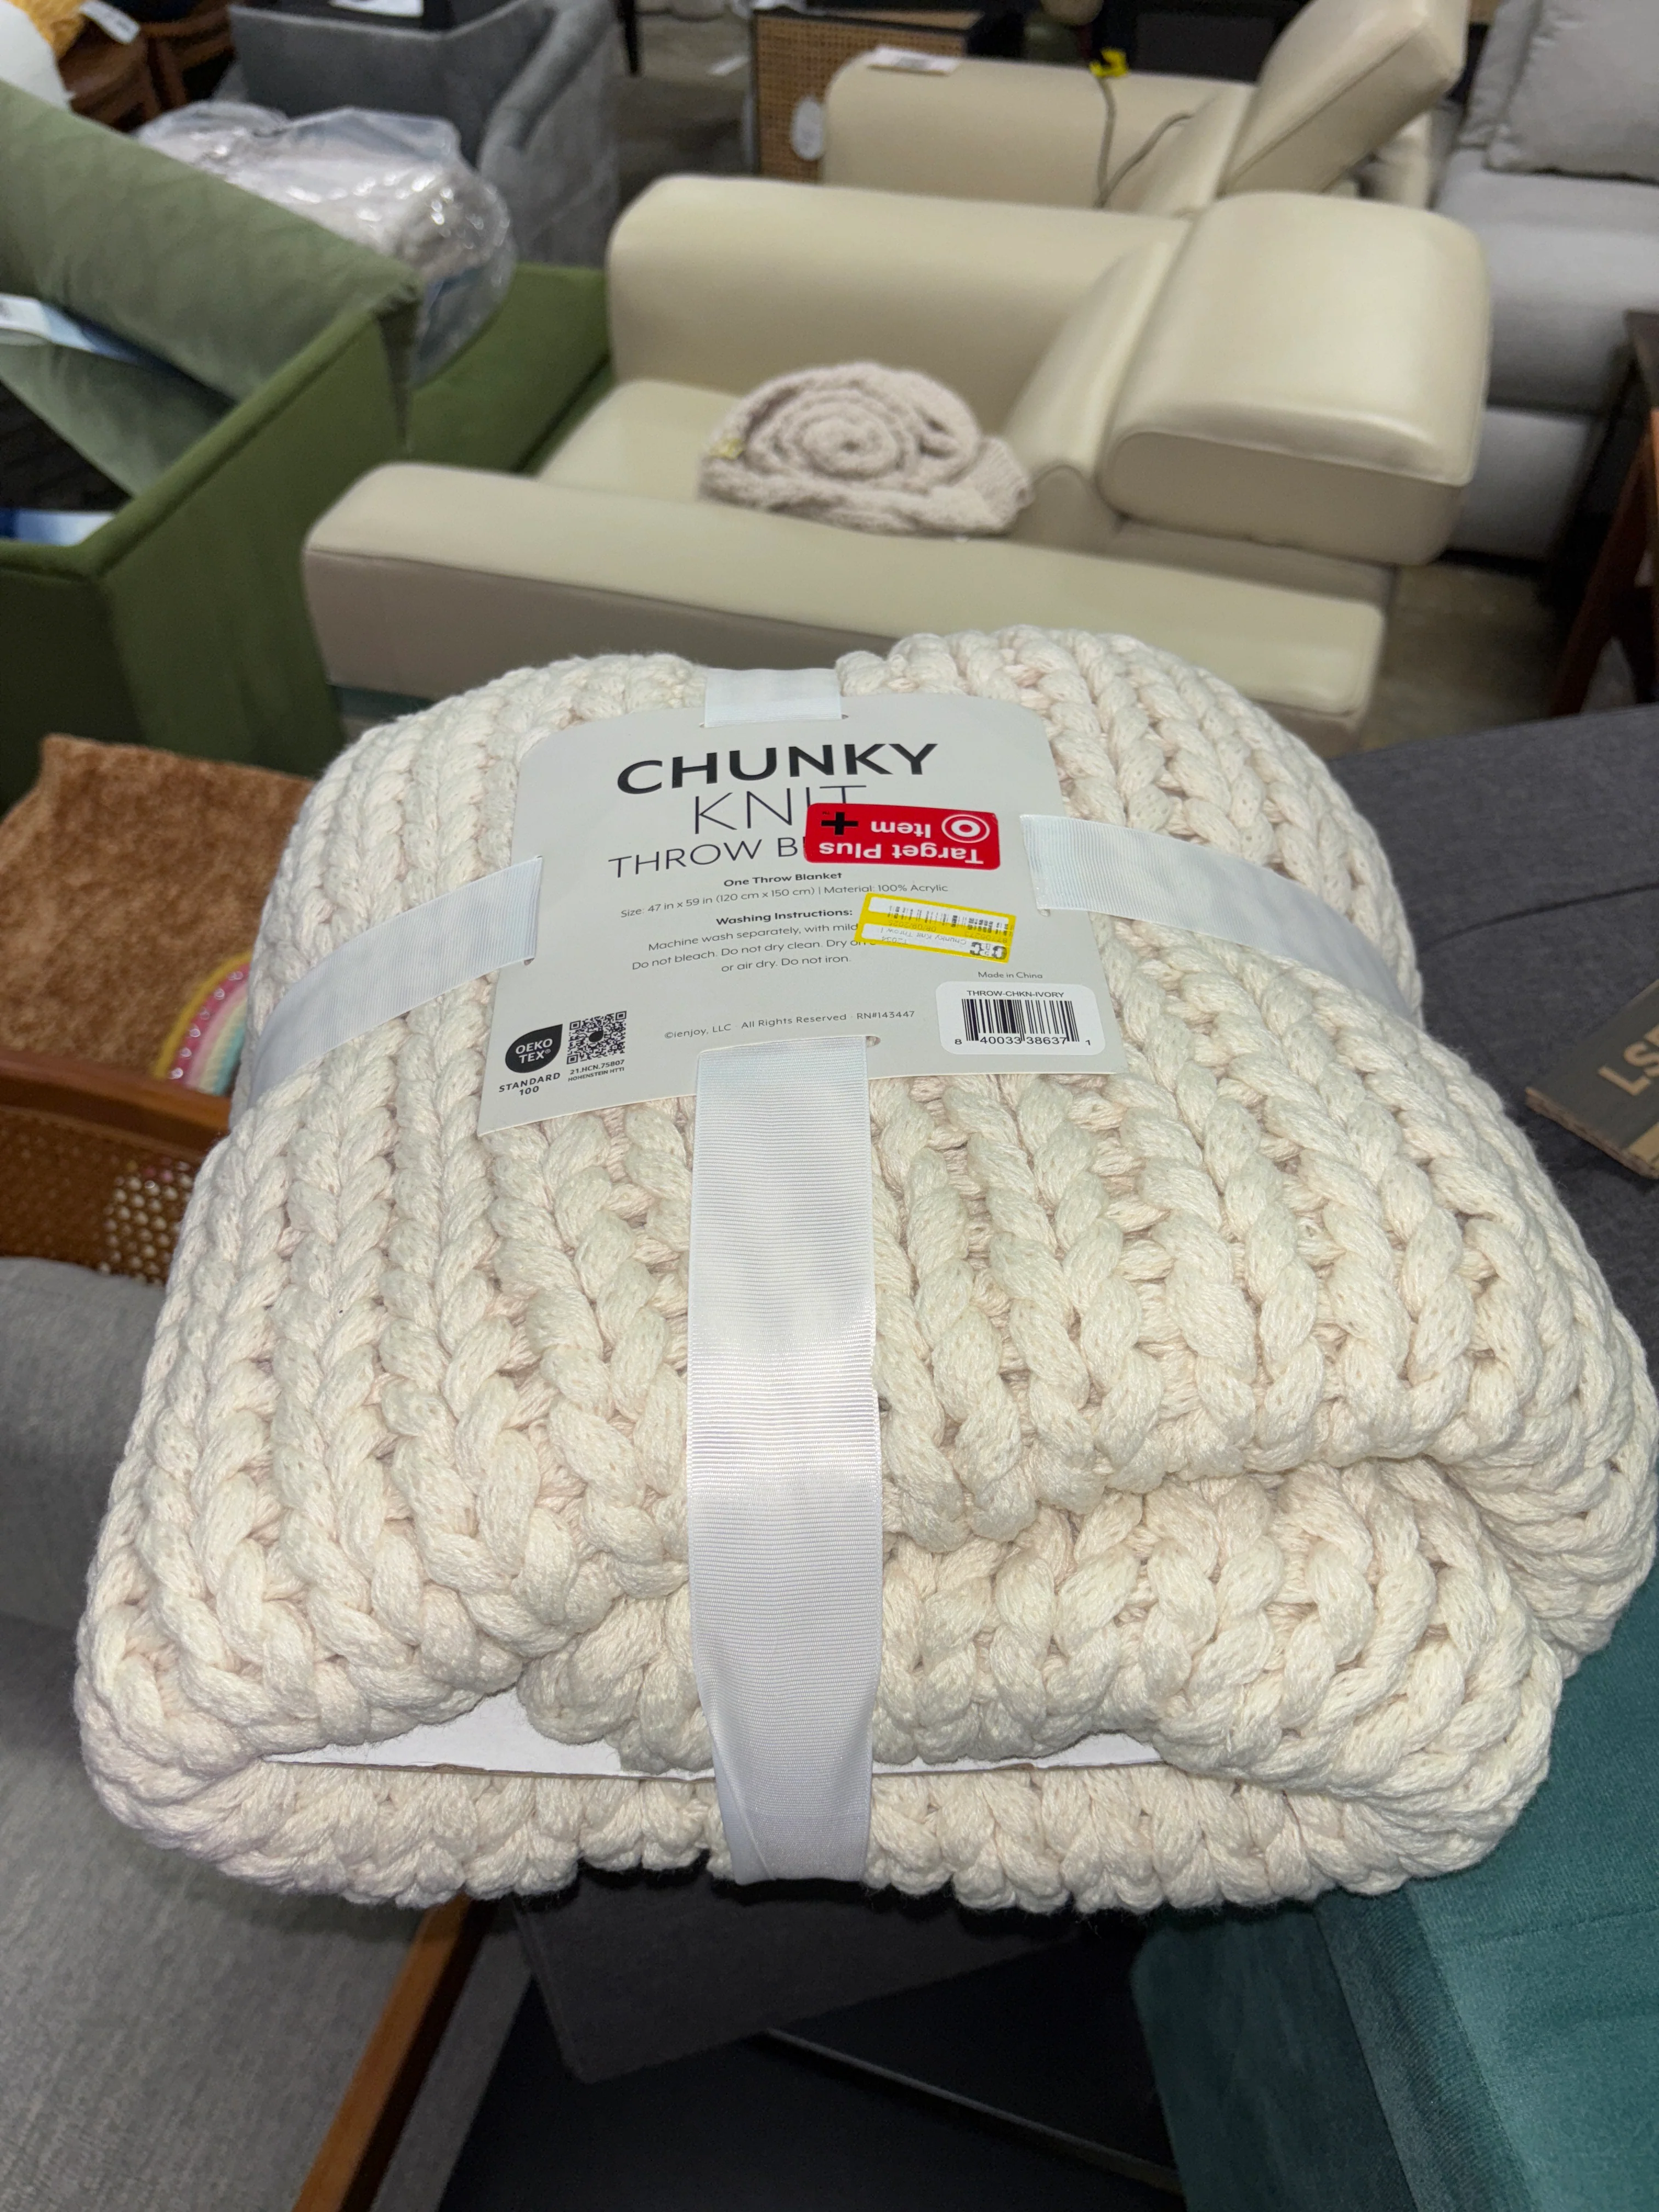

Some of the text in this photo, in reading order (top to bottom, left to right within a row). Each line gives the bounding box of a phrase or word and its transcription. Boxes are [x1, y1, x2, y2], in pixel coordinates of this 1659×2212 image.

[617, 744, 938, 794] CHUNKY
[870, 821, 931, 838] Item
[608, 839, 763, 878] THROW
[819, 842, 882, 859] Plus
[892, 842, 984, 865] Target
[724, 872, 842, 887] One Throw Blanket
[620, 907, 645, 918] Size:
[647, 904, 661, 912] 47
[686, 898, 699, 906] 59
[715, 893, 738, 903] (120
[771, 889, 789, 897] 150
[792, 887, 815, 896] cm)
[824, 885, 876, 894] Material:
[878, 884, 907, 892] 100%
[910, 884, 949, 893] Acrylic
[716, 909, 853, 926] Washing Instructions:
[648, 938, 699, 951] Machine
[701, 932, 733, 943] wash
[736, 926, 802, 939] separately,
[804, 924, 830, 933] with
[885, 927, 913, 938] Throw
[934, 934, 967, 945] Chunky
[632, 961, 649, 970] Do
[652, 957, 672, 967] not
[675, 950, 718, 963] bleach.
[721, 948, 738, 956] Do
[741, 944, 761, 954] not
[764, 943, 785, 953] dry
[787, 938, 823, 950] clean.
[827, 939, 848, 949] Dry
[737, 961, 753, 970] air
[755, 959, 778, 969] dry.
[781, 957, 799, 966] Do
[802, 956, 822, 965] not
[825, 955, 851, 963] iron.
[712, 1024, 732, 1033] LLC
[741, 1020, 755, 1029] All
[758, 1017, 793, 1028] Rights
[796, 1013, 847, 1023] Reserved
[856, 1011, 915, 1020] RN#143447
[515, 1038, 553, 1055] OEKO
[980, 1036, 1022, 1045] 40033
[1026, 1036, 1068, 1045] 38637
[569, 1059, 625, 1075] 21.HCN.75807
[1598, 1023, 1659, 1096] LS
[499, 1073, 561, 1092] STANDARD
[568, 1069, 608, 1082] HOHENSTEIN
[519, 1086, 540, 1096] 100
